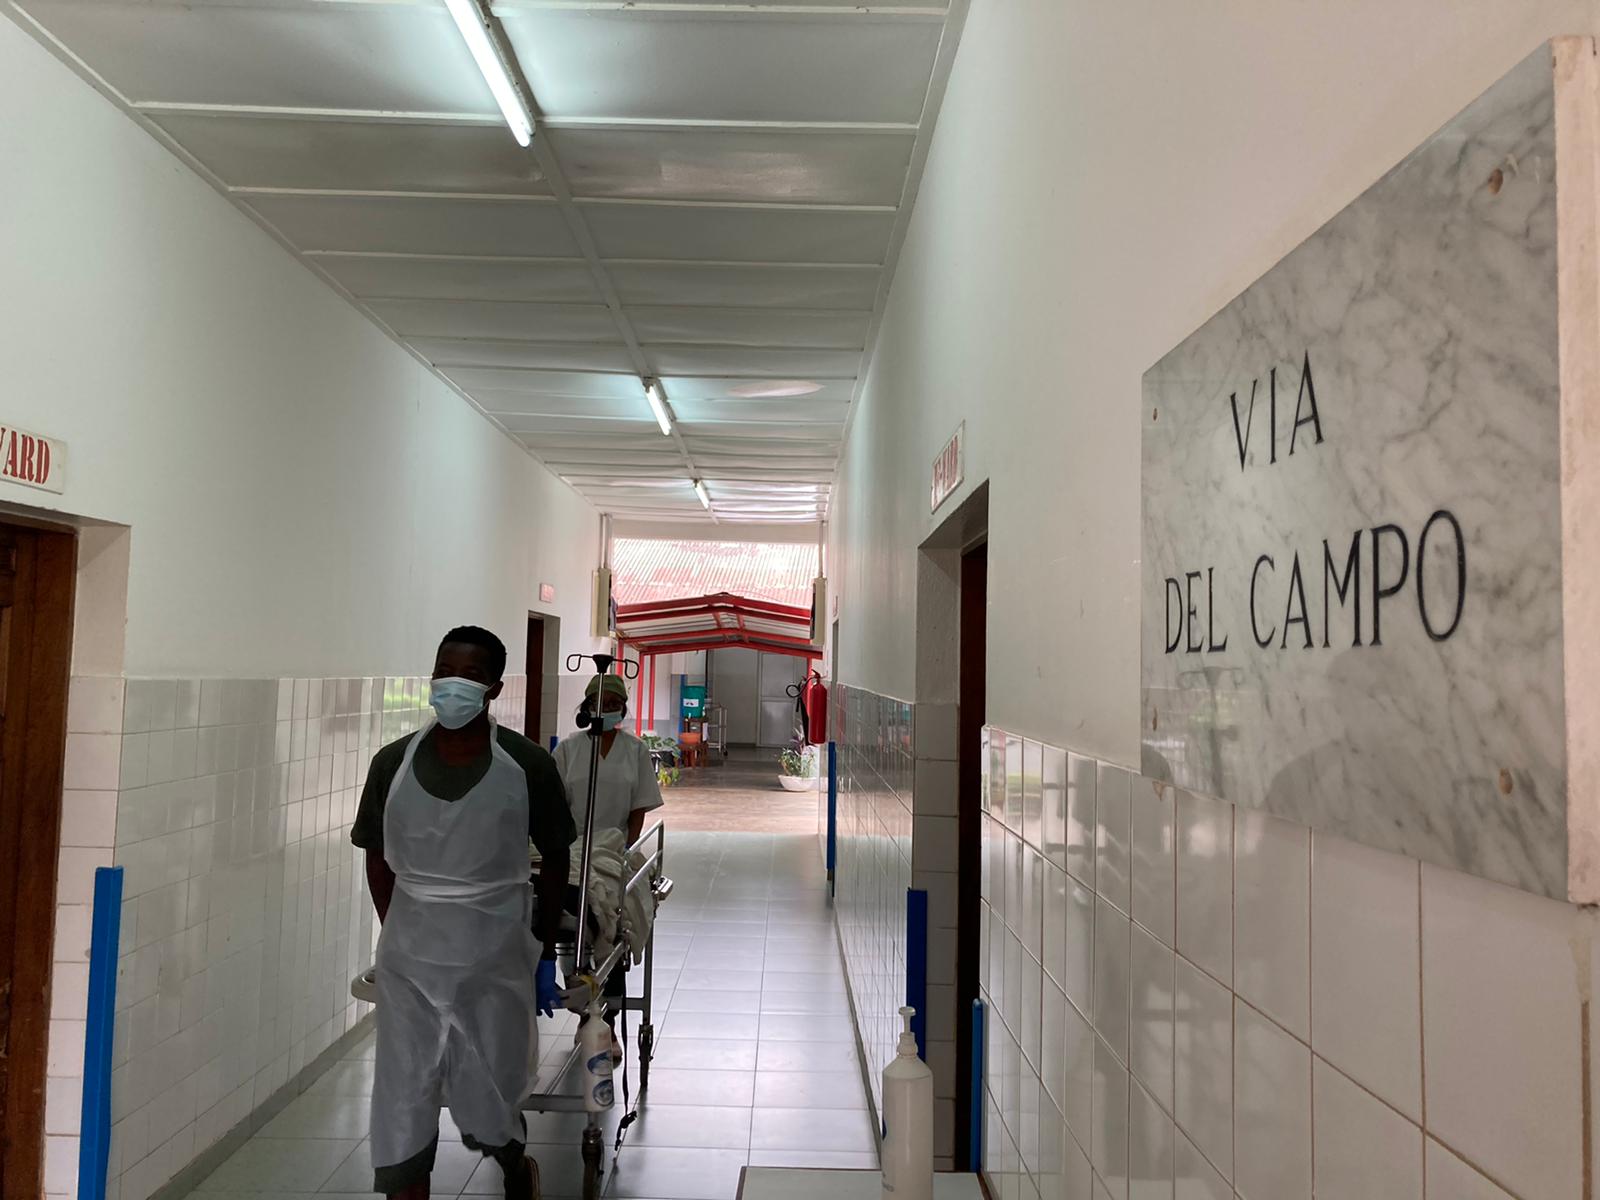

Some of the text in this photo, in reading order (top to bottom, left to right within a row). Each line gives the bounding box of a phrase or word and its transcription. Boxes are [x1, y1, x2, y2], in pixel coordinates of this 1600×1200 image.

[1230, 349, 1325, 473] VIA
[1164, 509, 1467, 654] DEL CAMPO
